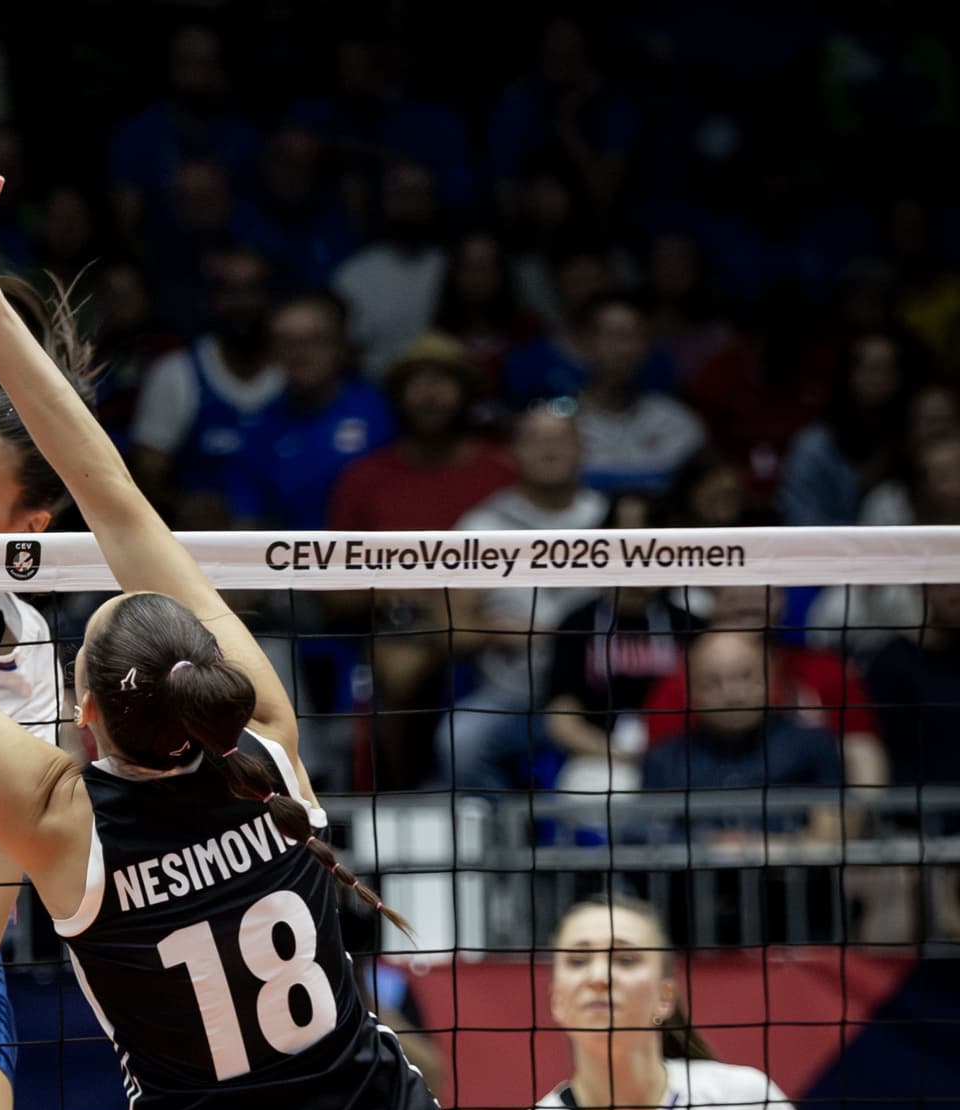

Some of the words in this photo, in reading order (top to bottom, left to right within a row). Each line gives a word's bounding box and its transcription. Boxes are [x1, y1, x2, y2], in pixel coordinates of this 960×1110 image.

[265, 540, 336, 571] CEV
[345, 538, 520, 577] EuroVolley
[530, 539, 610, 569] 2026
[620, 538, 745, 567] Women
[113, 812, 298, 912] NESIMOVI
[157, 890, 338, 1081] 18
